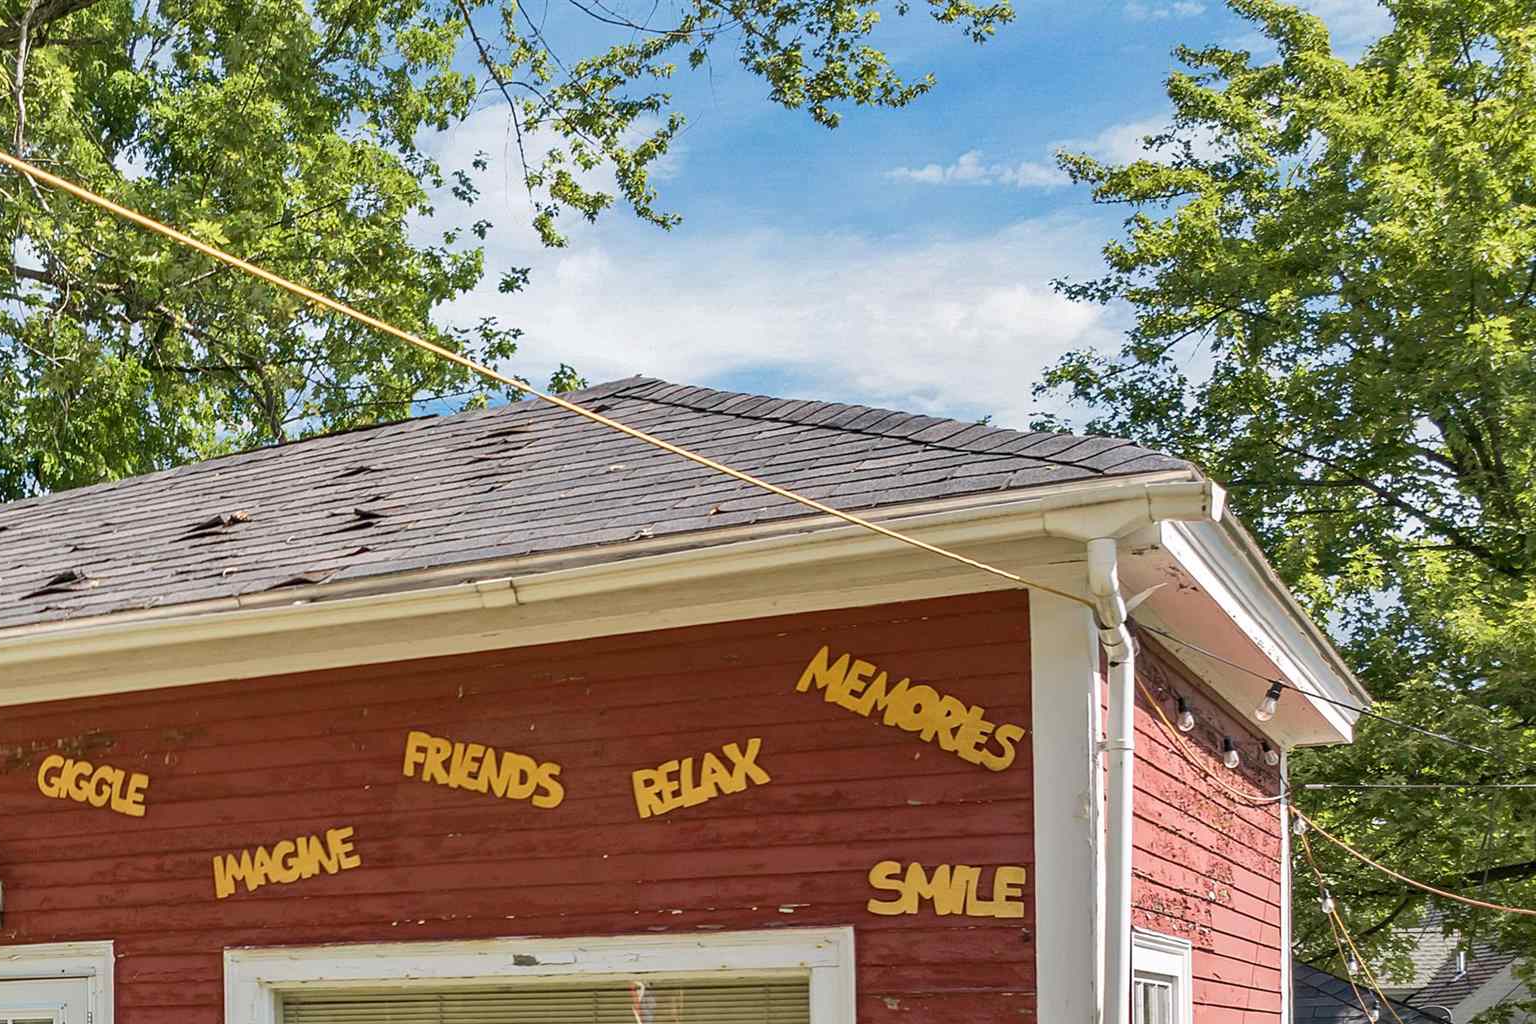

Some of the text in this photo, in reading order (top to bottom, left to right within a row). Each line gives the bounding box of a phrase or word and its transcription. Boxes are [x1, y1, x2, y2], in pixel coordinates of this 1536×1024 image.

[37, 754, 149, 817] GIGGLE
[402, 731, 564, 810] FRIENDS
[632, 738, 770, 819] RELAX
[213, 826, 360, 898] IMAGINE
[867, 861, 1026, 918] SMILE
